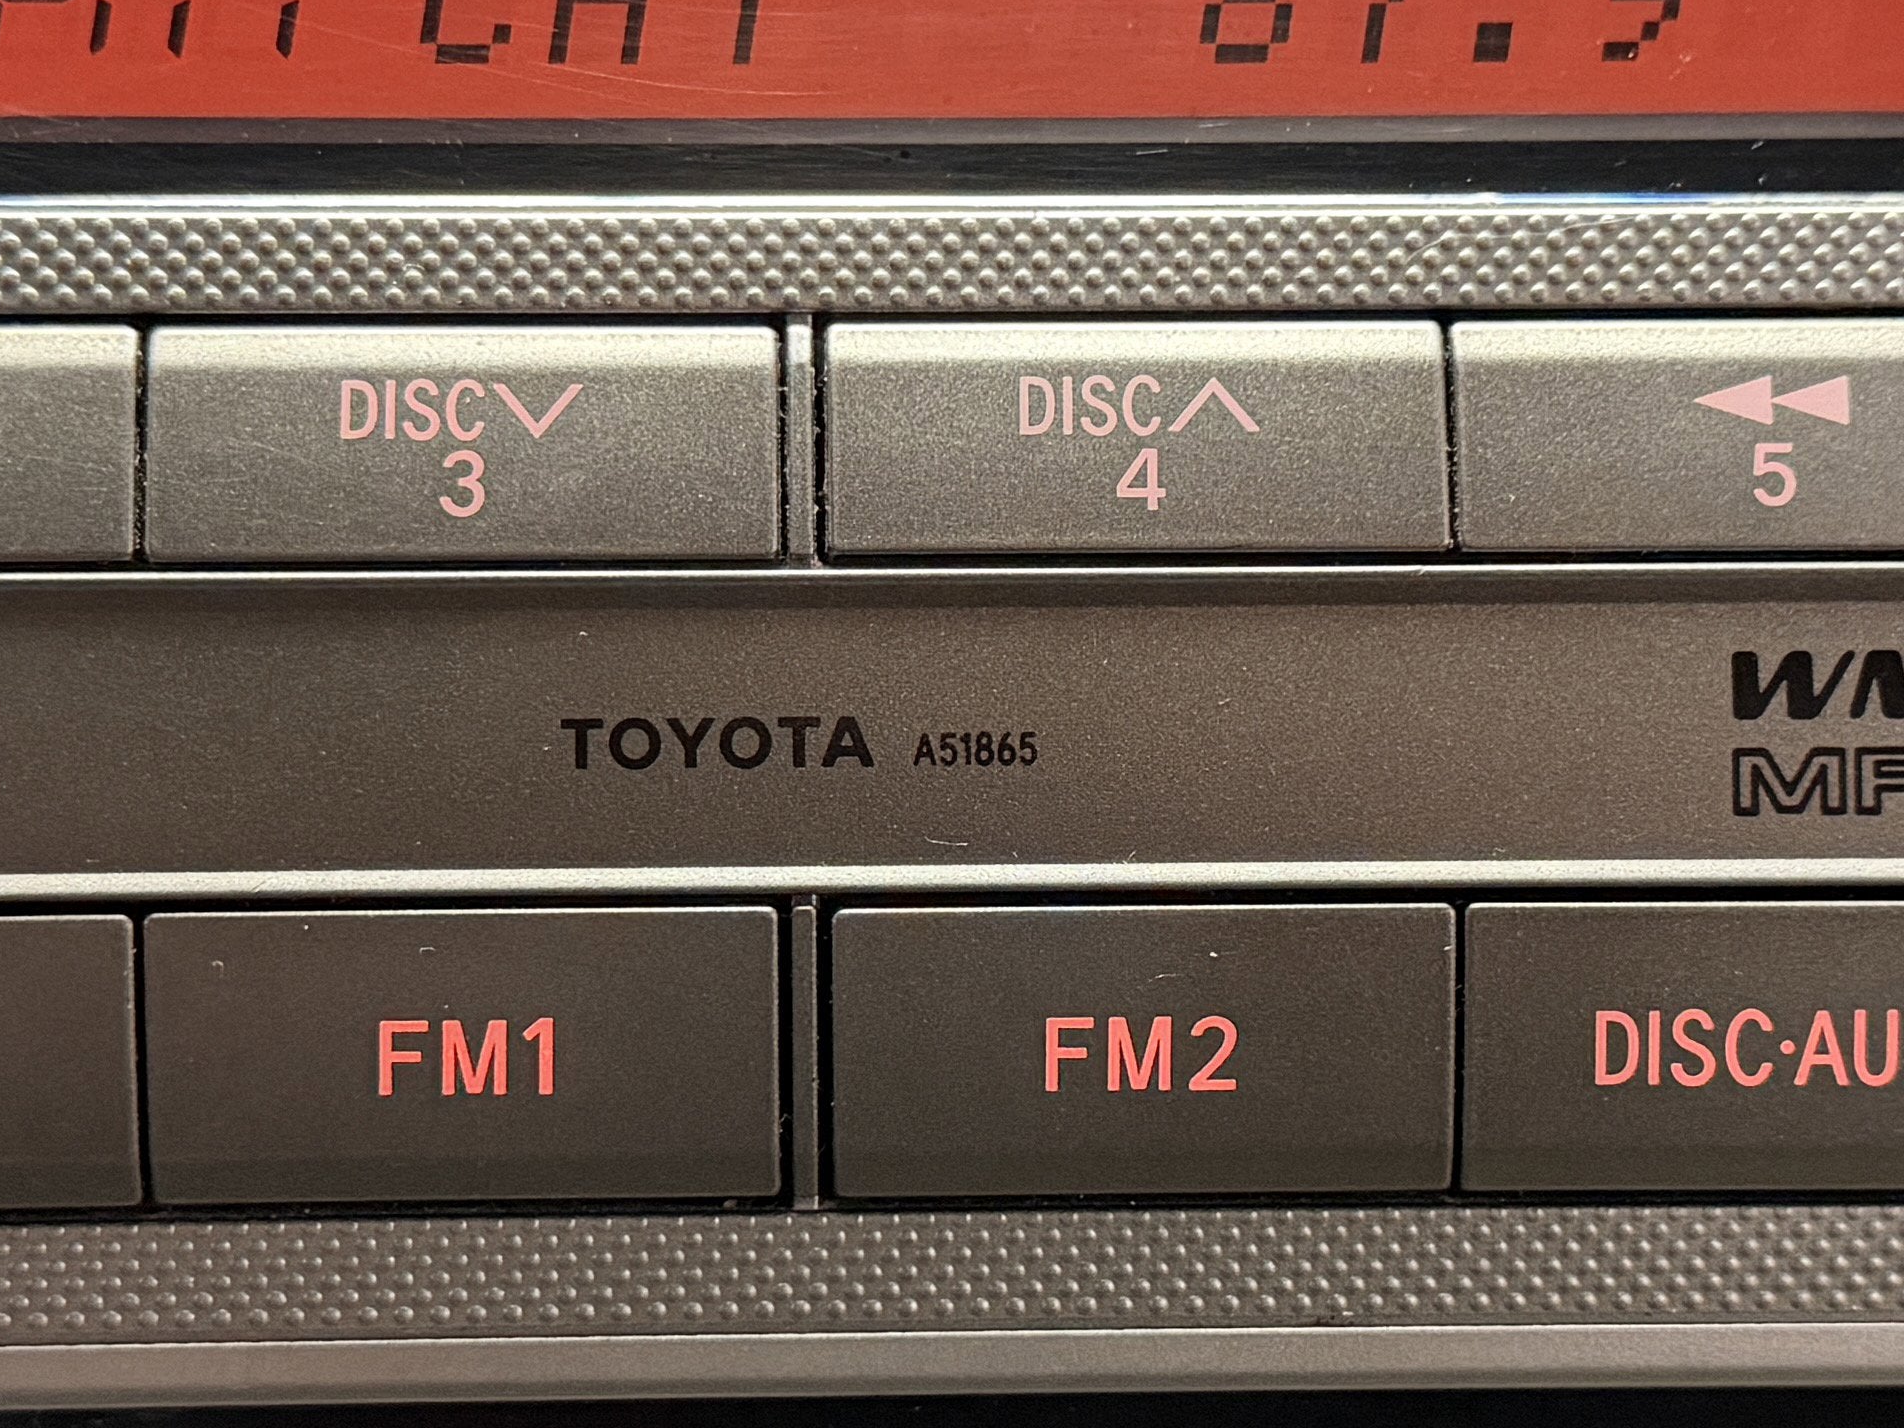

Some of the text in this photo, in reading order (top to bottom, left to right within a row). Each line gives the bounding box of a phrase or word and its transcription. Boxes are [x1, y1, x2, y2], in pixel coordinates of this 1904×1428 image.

[340, 378, 486, 441] DISC
[1018, 374, 1162, 437] DISC
[439, 449, 485, 517] 3
[1115, 447, 1166, 511] 4
[1752, 442, 1798, 507] 5
[560, 716, 1039, 770] TOYOTA A51865
[378, 1017, 555, 1097] FM1
[1044, 1015, 1239, 1092] FM2
